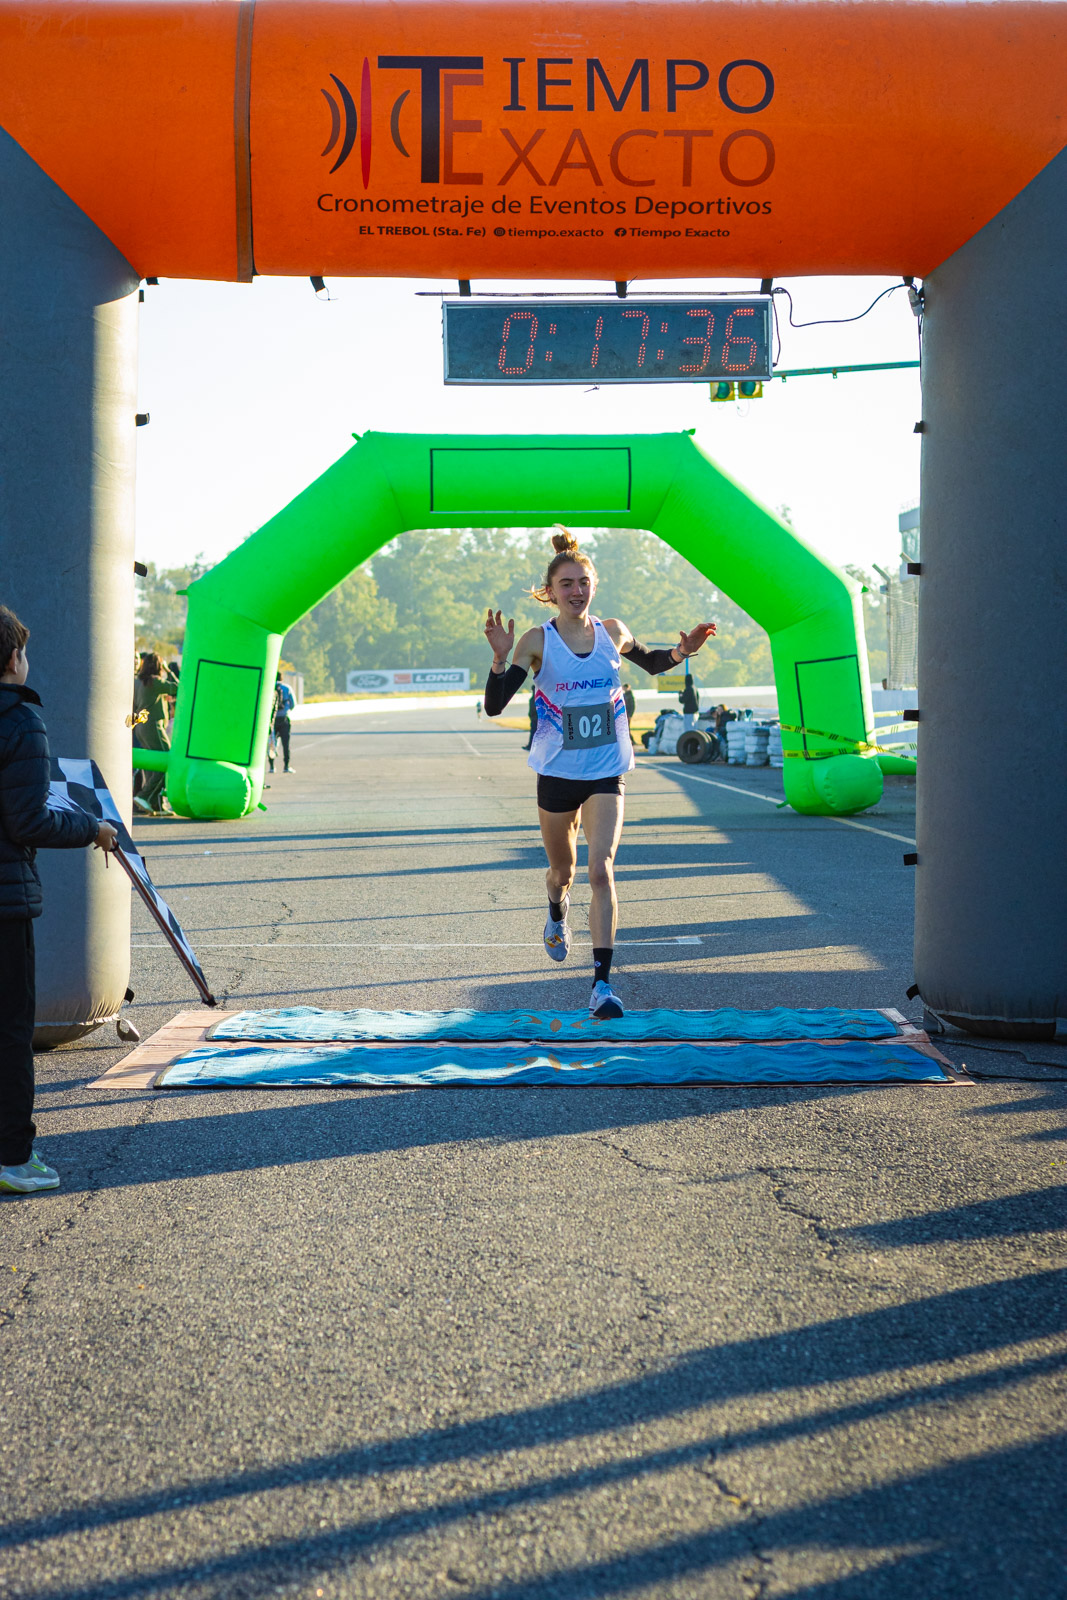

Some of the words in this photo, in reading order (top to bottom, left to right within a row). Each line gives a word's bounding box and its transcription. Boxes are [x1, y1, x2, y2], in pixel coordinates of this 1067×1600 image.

[317, 193, 484, 218] Cronometraje
[491, 194, 522, 214] de
[530, 195, 627, 215] Eventos
[634, 196, 772, 220] Deportivos
[359, 225, 375, 235] EL
[376, 225, 430, 236] TREBOL
[432, 226, 464, 238] (Sta.
[466, 226, 487, 238] Fe)
[507, 227, 605, 240] tiempo.exacto
[628, 227, 682, 240] Tiempo
[684, 228, 731, 239] Exacto
[498, 307, 757, 375] 0:17:36
[415, 673, 460, 682] LONG
[556, 678, 613, 692] RUNNEA
[578, 713, 602, 739] 02
